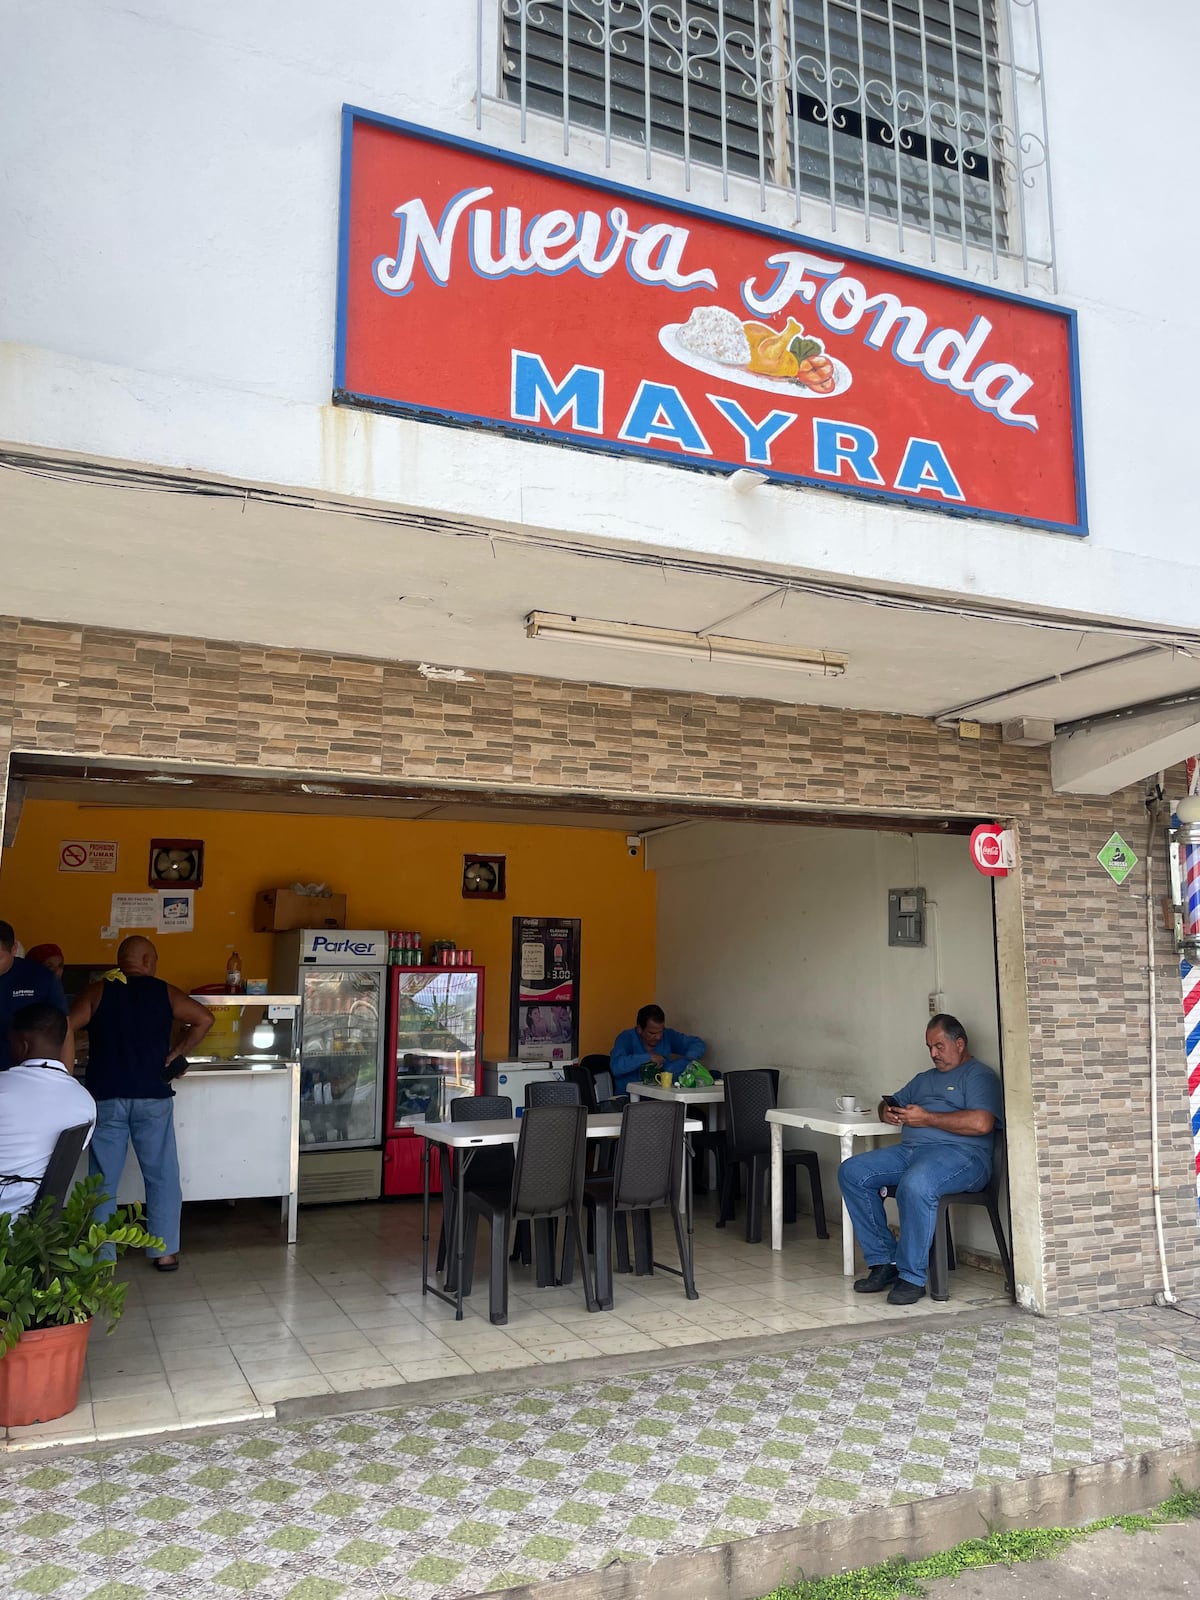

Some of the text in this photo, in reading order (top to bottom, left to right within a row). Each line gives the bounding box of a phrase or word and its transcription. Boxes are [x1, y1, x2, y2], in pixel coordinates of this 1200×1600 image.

[372, 185, 1040, 432] Nueva Fonda
[510, 348, 967, 502] MAYRA
[312, 936, 376, 956] Parker
